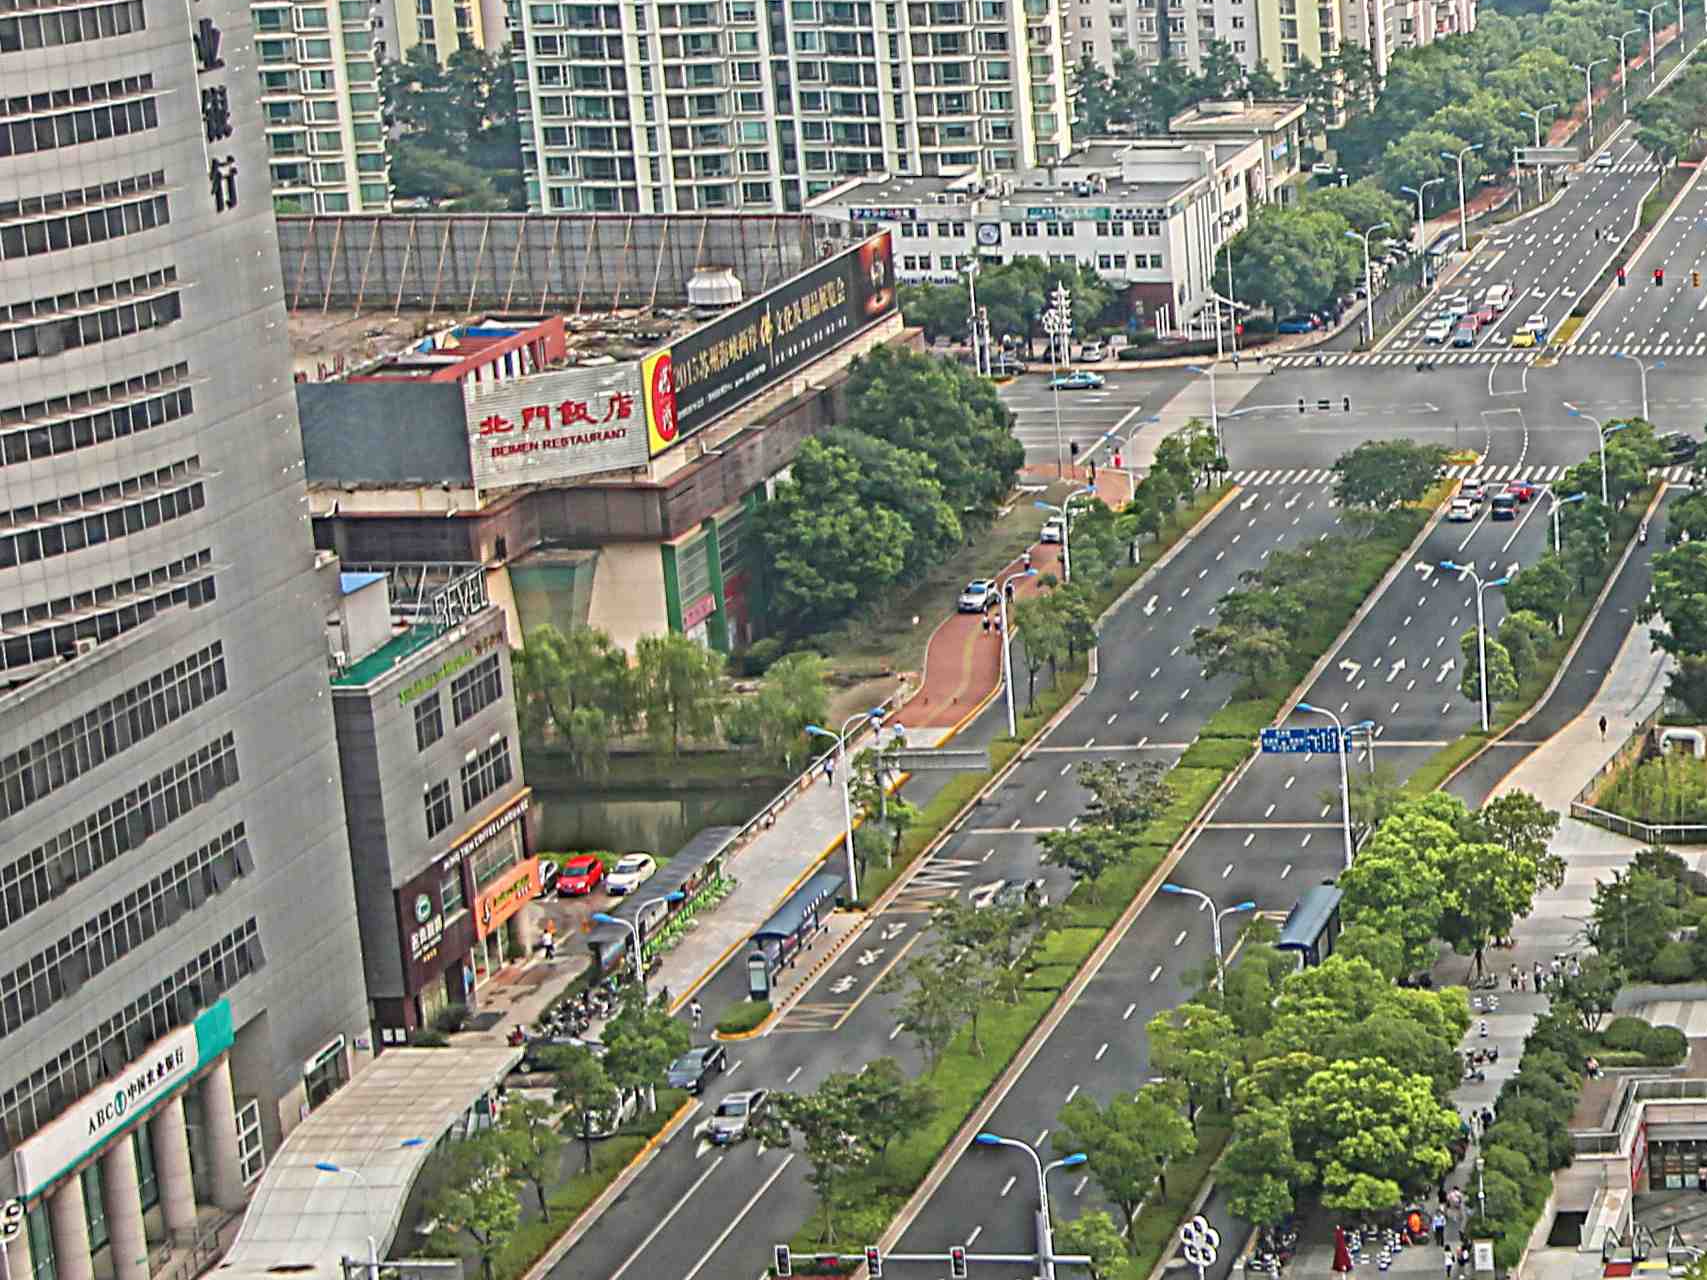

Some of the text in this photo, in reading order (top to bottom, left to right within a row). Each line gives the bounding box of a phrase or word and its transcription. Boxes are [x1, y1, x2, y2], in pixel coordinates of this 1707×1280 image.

[479, 391, 635, 436] 北門飯店
[491, 428, 628, 458] BEIMEN RESTAURANT
[88, 1103, 114, 1136] ABC
